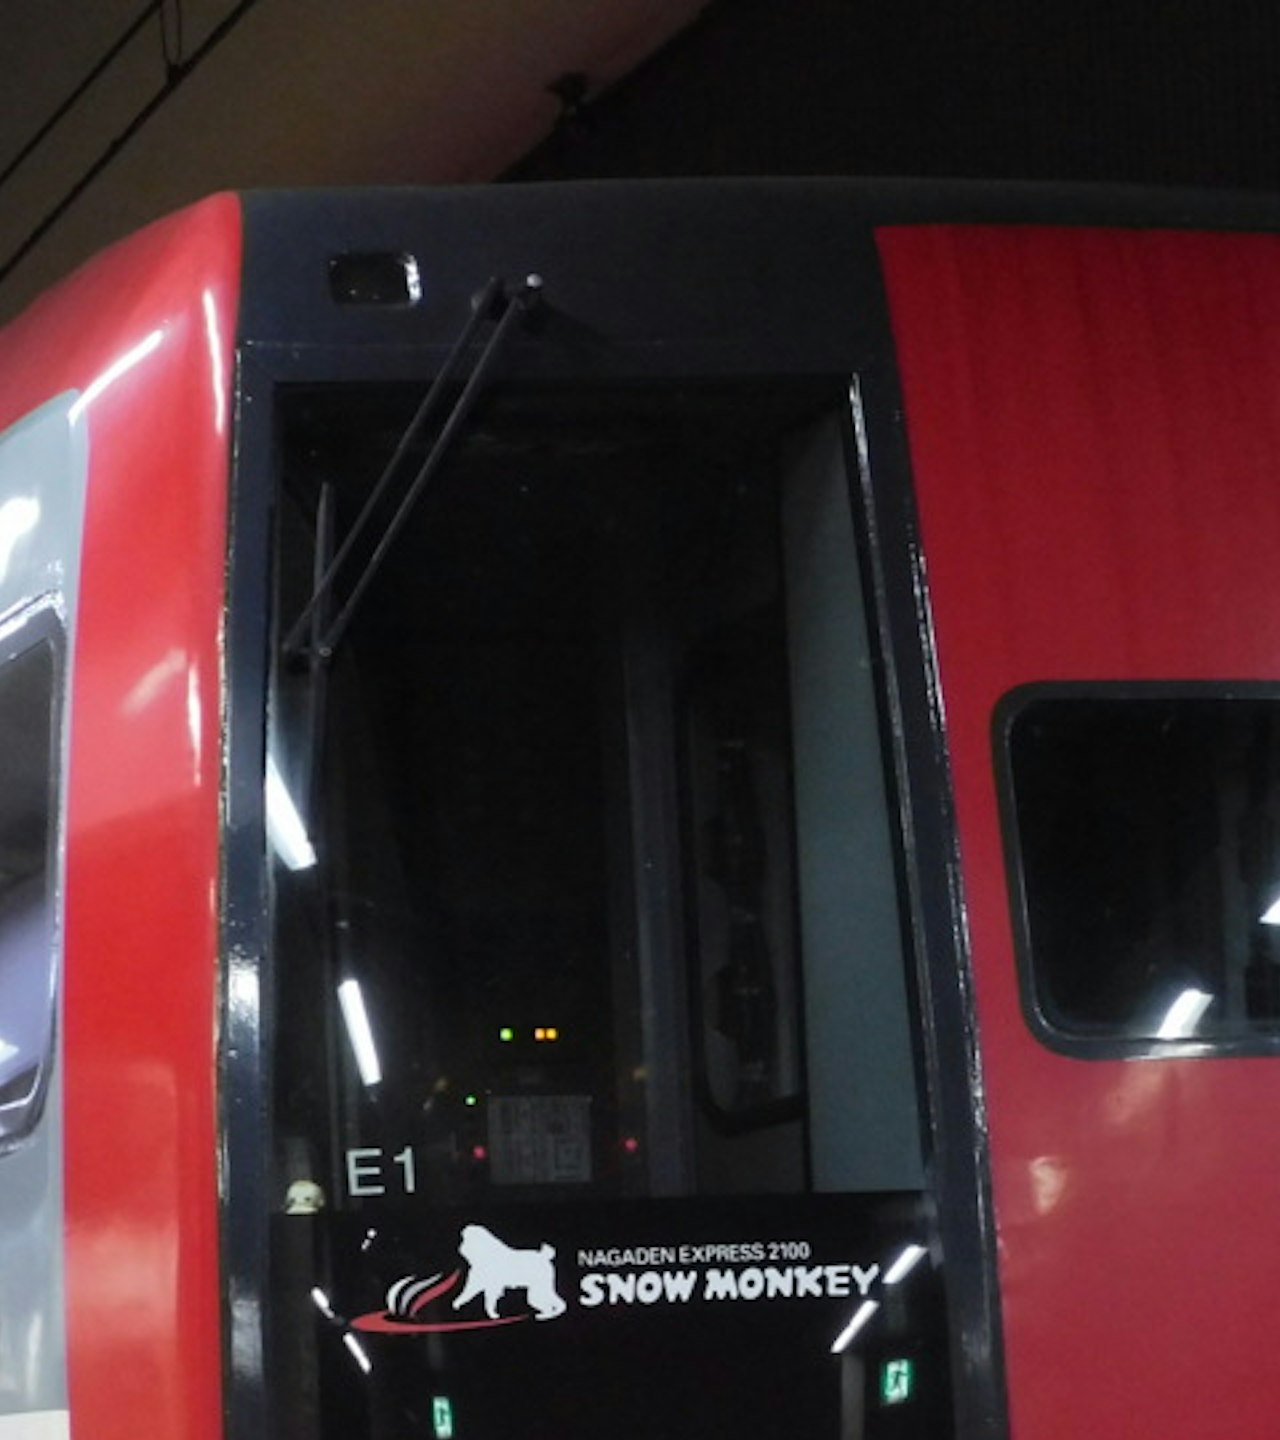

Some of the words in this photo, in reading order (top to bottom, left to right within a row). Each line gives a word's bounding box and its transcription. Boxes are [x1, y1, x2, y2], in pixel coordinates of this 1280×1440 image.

[346, 1145, 416, 1196] E1
[578, 1247, 675, 1266] NAGADEN
[679, 1243, 765, 1263] EXPRESS
[767, 1242, 810, 1260] 2100
[580, 1271, 697, 1306] SNOW
[704, 1264, 879, 1301] MONKEY
